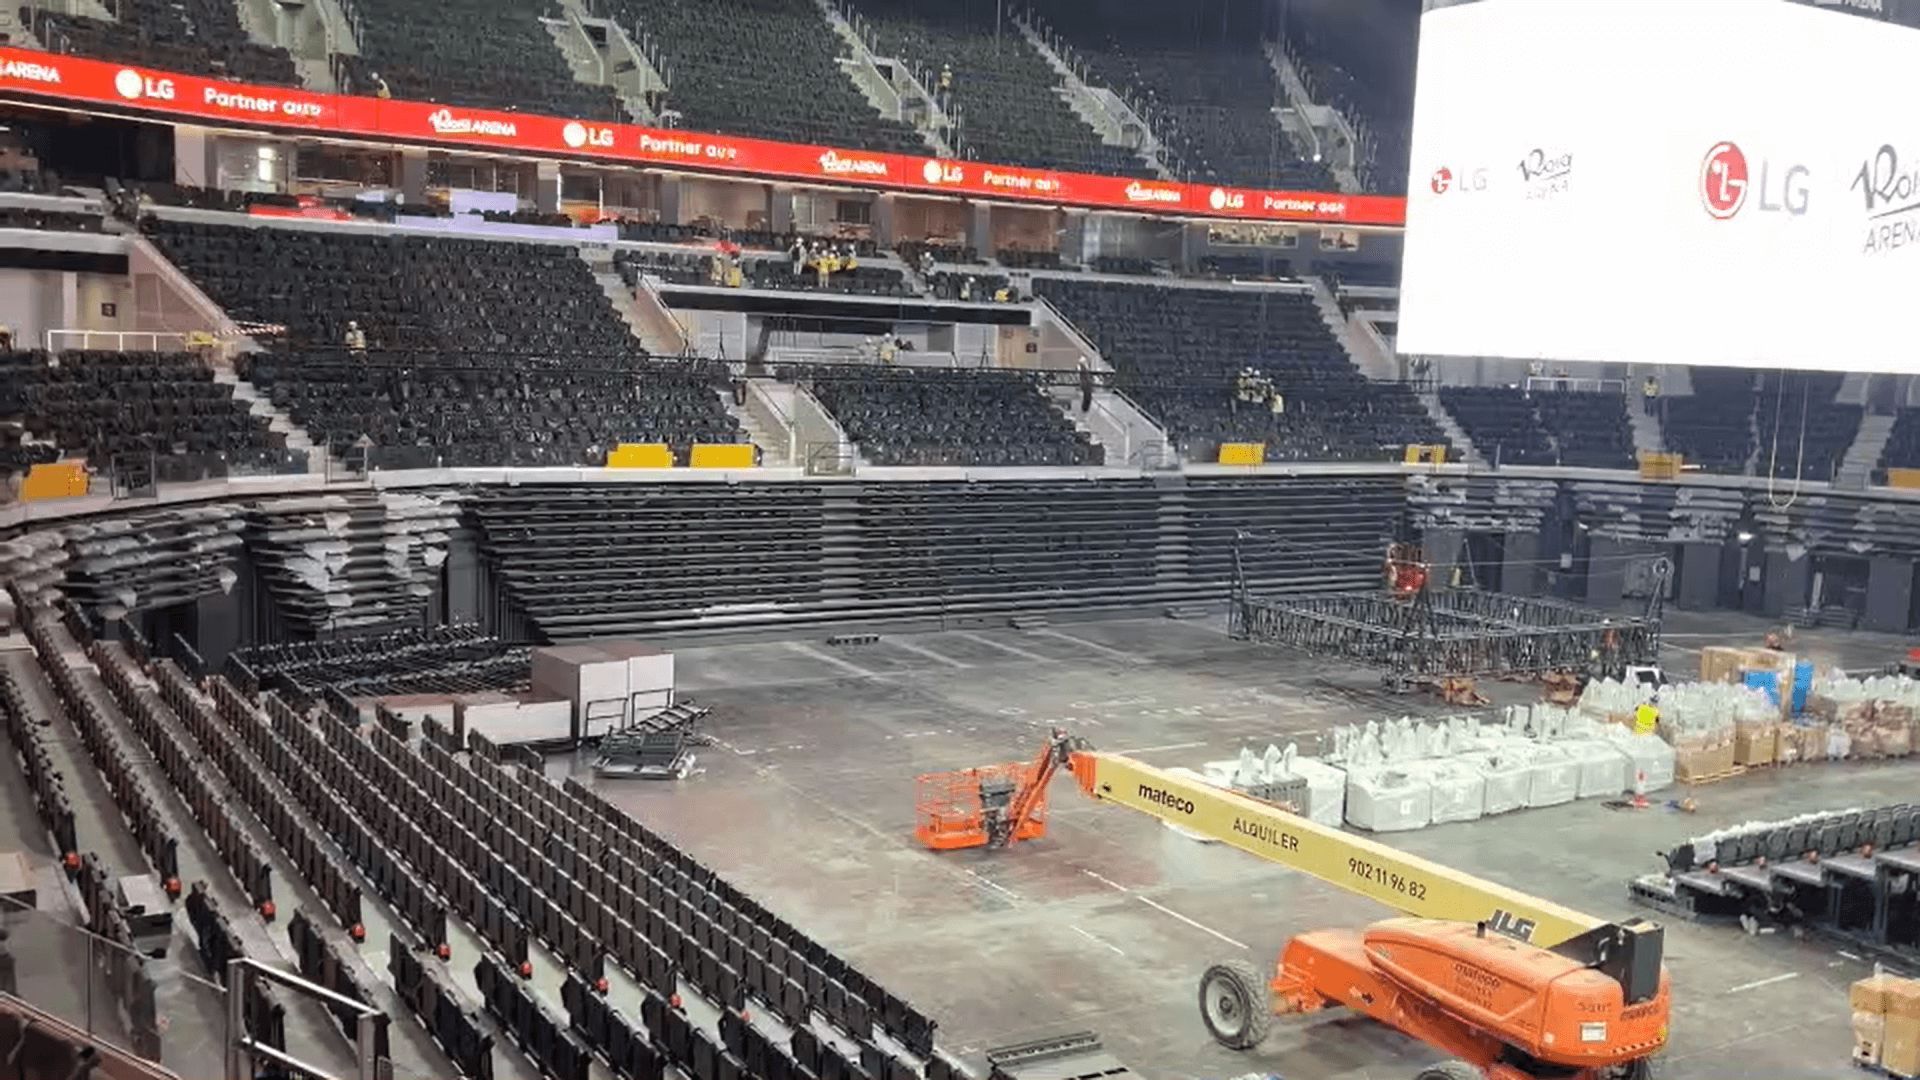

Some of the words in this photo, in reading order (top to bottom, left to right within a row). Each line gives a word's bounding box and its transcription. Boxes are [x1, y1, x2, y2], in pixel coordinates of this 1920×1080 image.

[6, 60, 62, 83] ARENA
[145, 78, 175, 100] LG
[204, 87, 277, 112] Partner
[590, 130, 613, 146] LG
[640, 134, 701, 155] Partner
[943, 167, 963, 183] LG
[983, 170, 1031, 189] Partner
[1459, 165, 1489, 191] LG
[1758, 158, 1810, 216] LG
[1851, 144, 1920, 218] Roi
[1226, 193, 1244, 208] LG
[1264, 195, 1316, 212] Partner
[1863, 220, 1920, 254] AREN
[1138, 782, 1195, 815] mateco
[1233, 817, 1299, 852] ALQUILER
[1348, 857, 1374, 881] 902
[1375, 868, 1387, 886] 11
[1391, 873, 1406, 893] 96
[1409, 881, 1427, 900] 82
[1485, 909, 1536, 942] JLG
